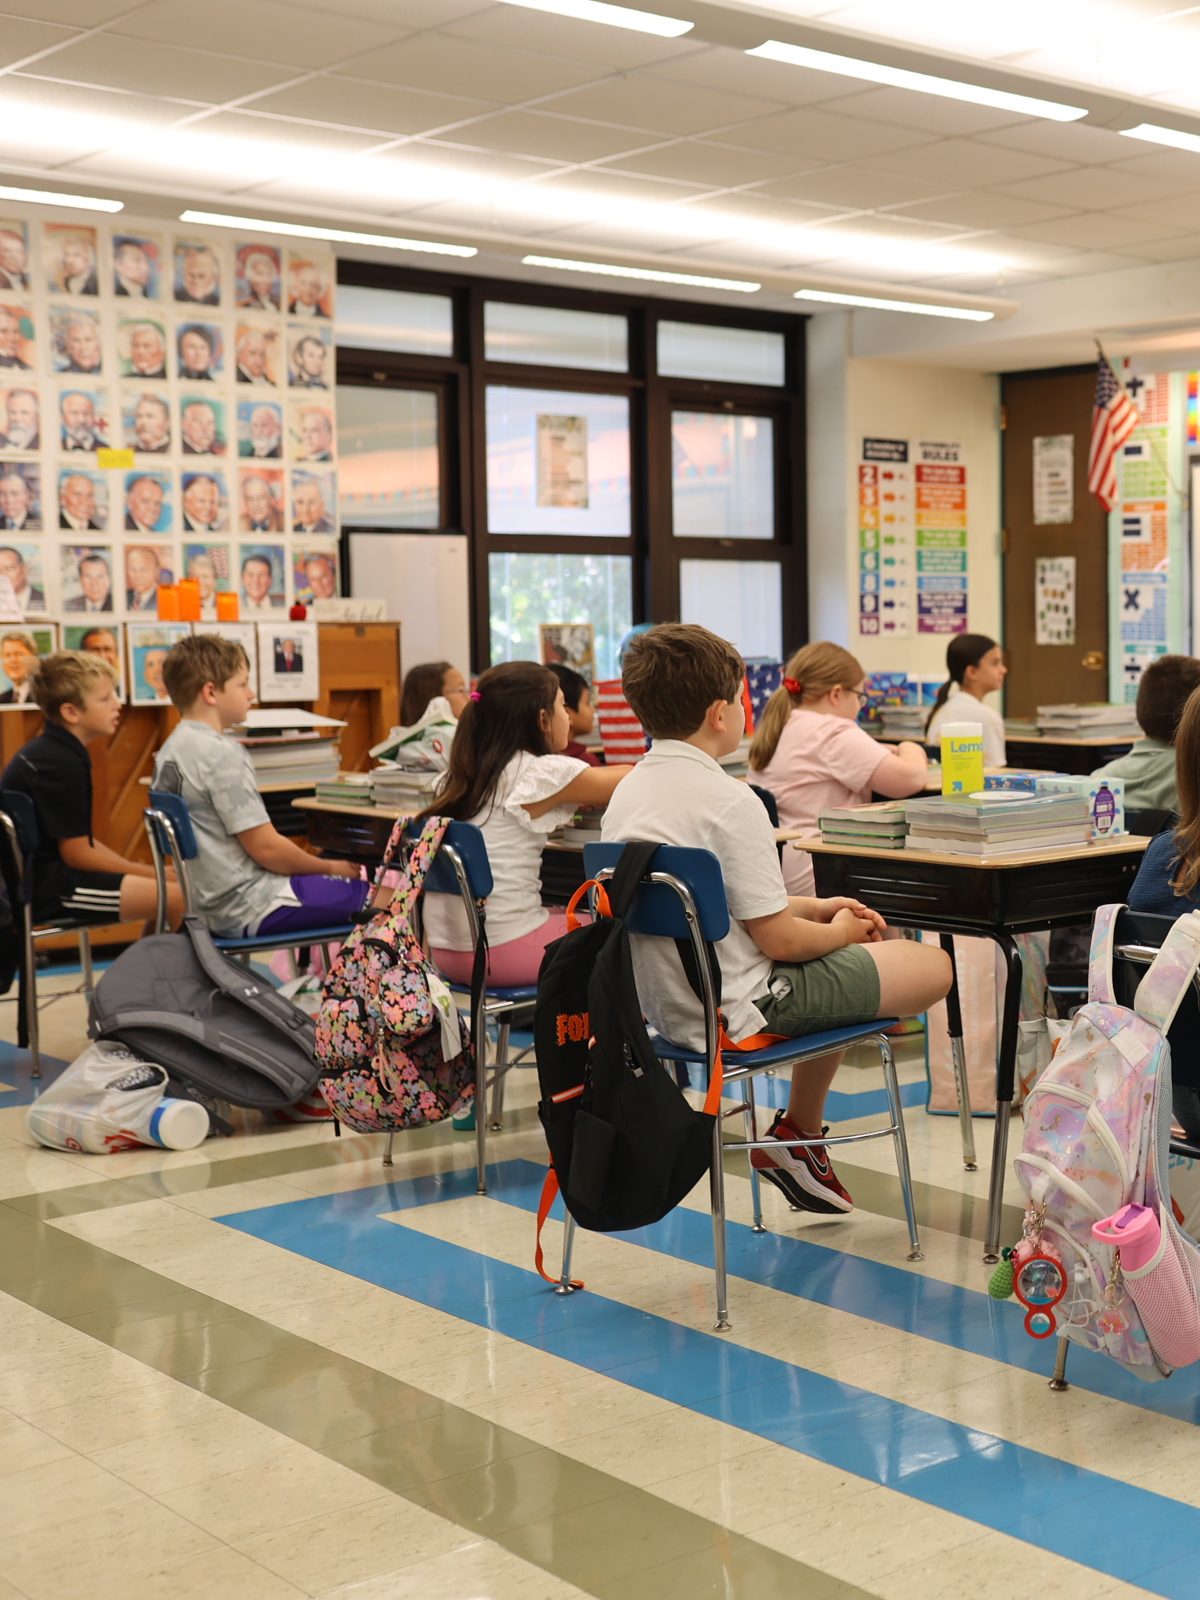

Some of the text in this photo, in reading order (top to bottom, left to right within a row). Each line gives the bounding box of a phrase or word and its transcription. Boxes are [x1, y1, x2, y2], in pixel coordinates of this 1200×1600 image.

[922, 451, 959, 460] RULES
[862, 467, 875, 484] 2
[863, 487, 875, 505] 3
[864, 509, 876, 526] 4
[865, 530, 876, 548] 5
[864, 552, 876, 570] 6
[865, 574, 877, 591] 8
[863, 594, 876, 613] 9
[861, 617, 878, 634] 10
